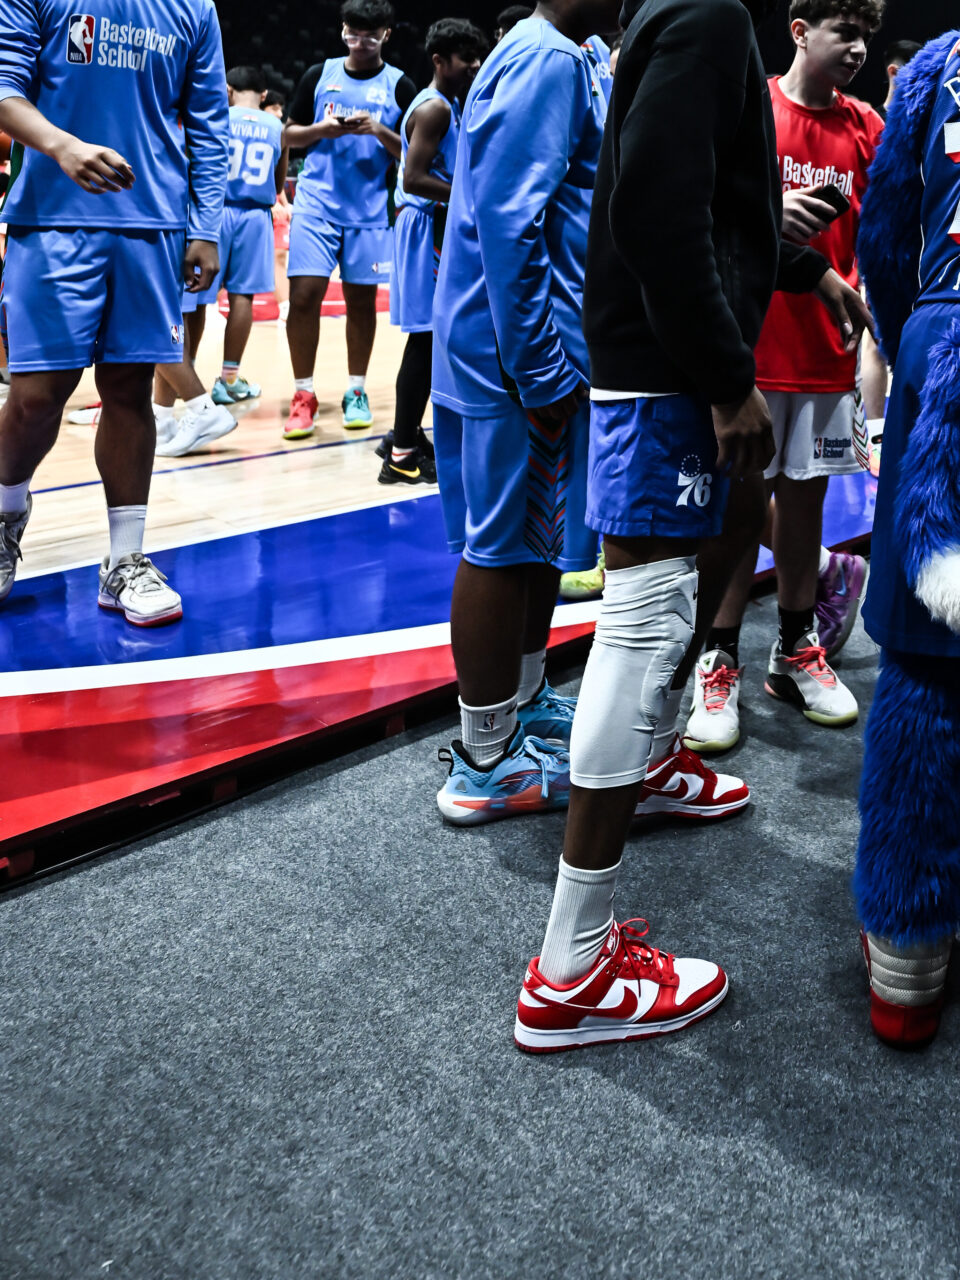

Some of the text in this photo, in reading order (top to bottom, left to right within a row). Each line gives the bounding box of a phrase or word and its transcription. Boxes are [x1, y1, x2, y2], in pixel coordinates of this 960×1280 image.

[99, 16, 178, 57] Basketball
[366, 86, 387, 105] 23
[231, 122, 269, 140] VIVAAN
[782, 154, 854, 197] Basketball
[675, 471, 713, 507] 76
